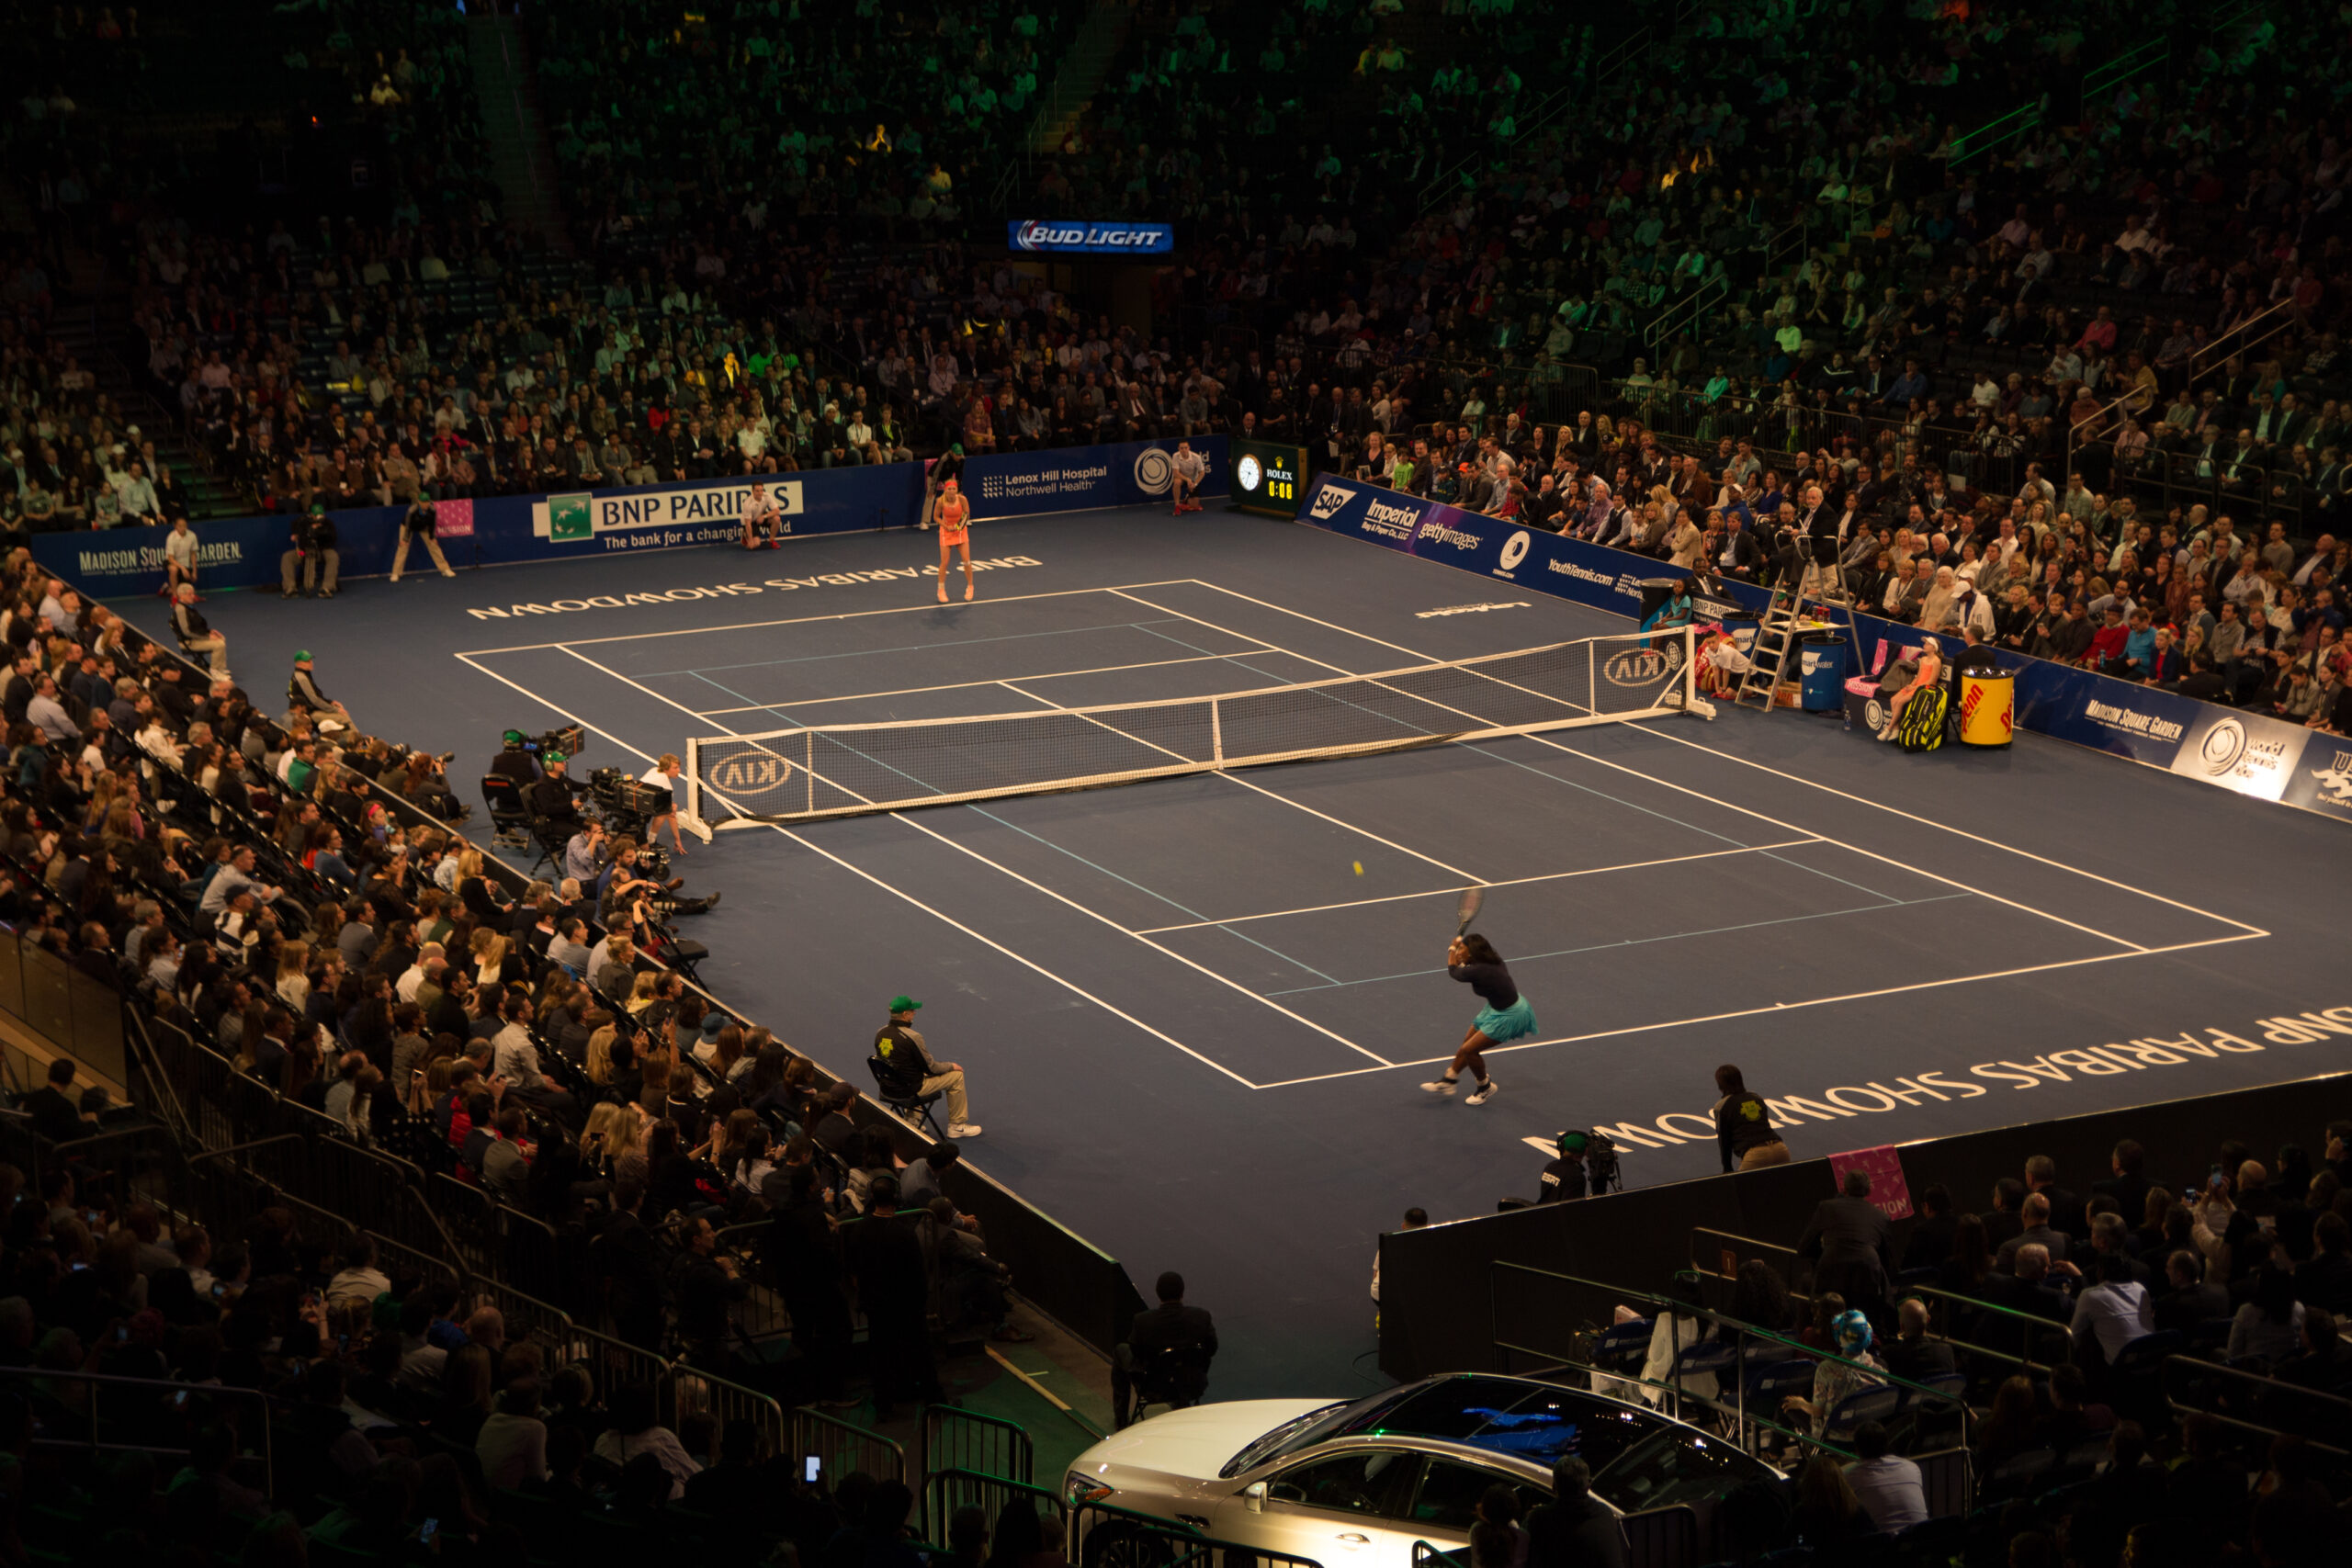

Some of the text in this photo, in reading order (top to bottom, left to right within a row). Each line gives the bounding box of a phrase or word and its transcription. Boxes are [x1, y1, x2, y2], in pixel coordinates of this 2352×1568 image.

[1028, 226, 1162, 246] BUD LIGHT
[1005, 465, 1107, 485] Lenox Hill Hospital
[1266, 468, 1293, 481] ROLEX
[1006, 482, 1057, 497] Northwell
[1315, 491, 1344, 513] SAP
[603, 486, 789, 525] BNP PARIBS
[1366, 497, 1420, 528] Imperial
[604, 536, 628, 550] The
[630, 532, 662, 547] bank
[663, 530, 684, 547] for
[685, 532, 695, 543] a
[697, 525, 745, 542] changin
[1419, 522, 1481, 550] gettyimages
[79, 549, 137, 571] MADISON
[1547, 558, 1614, 586] YouthTennis.com
[466, 555, 1044, 622] BNP PARIBAS SHOWDOWN
[1693, 599, 1709, 613] BNP
[2085, 699, 2123, 723] MADISON
[2119, 707, 2153, 731] SQUARE
[1970, 1027, 2267, 1090] PARIBAS
